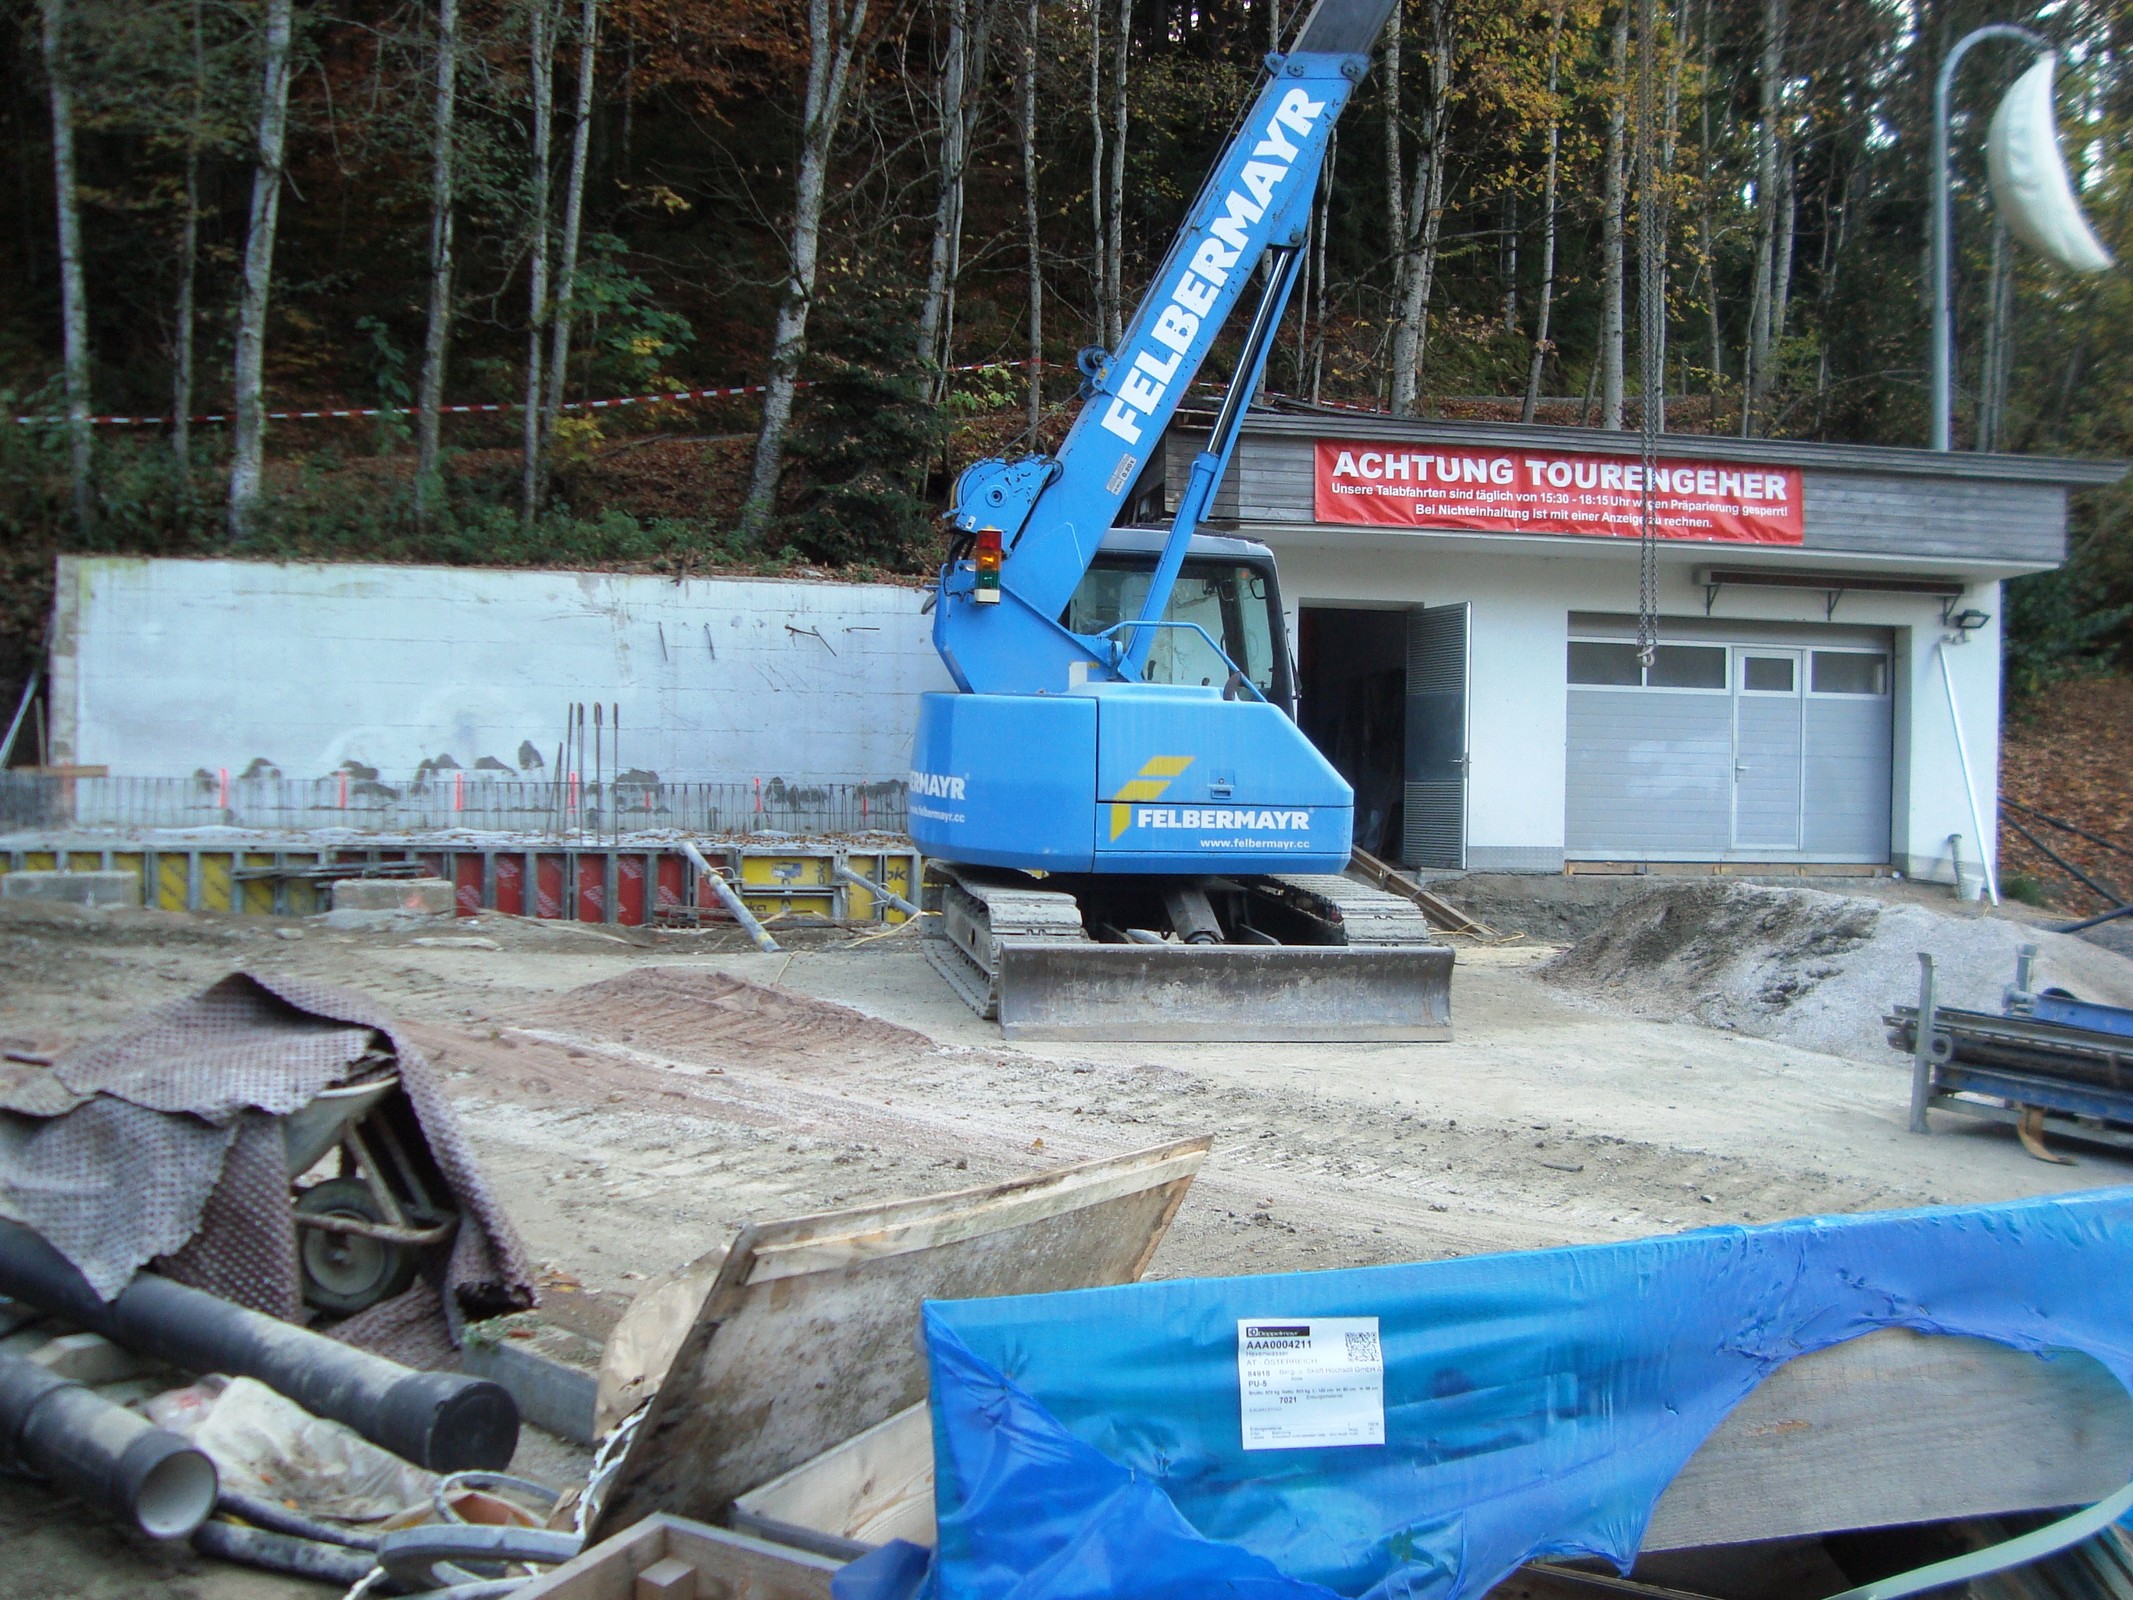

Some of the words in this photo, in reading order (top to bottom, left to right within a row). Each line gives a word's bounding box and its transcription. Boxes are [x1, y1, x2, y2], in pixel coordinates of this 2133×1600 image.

[1101, 88, 1325, 445] FELBERMAYR
[1332, 451, 1514, 485] ACHTUNG
[1525, 459, 1787, 500] TOURENGEHER
[1332, 482, 1373, 495] Unsere
[1376, 484, 1447, 498] Talabfahrten
[1449, 488, 1473, 500] sind
[1476, 489, 1513, 502] täglich
[1516, 493, 1537, 502] von
[1540, 492, 1569, 504] 15:30
[1579, 494, 1609, 505] 18:15
[1610, 495, 1630, 506] Uhr
[1632, 499, 1668, 511] wgen
[1671, 499, 1739, 515] Präparierung
[1742, 505, 1788, 517] gesperrt!
[1415, 503, 1435, 515] Bei
[1438, 504, 1530, 521] Nichteinhaltung
[1533, 508, 1548, 519] ist
[1550, 510, 1568, 520] mit
[1571, 510, 1600, 521] einer
[1601, 511, 1645, 526] Anzeige
[1664, 516, 1713, 528] rechnen.
[1137, 809, 1310, 830] FELBERMAYR
[1200, 838, 1310, 850] www.felbermayr.cc
[1246, 1340, 1312, 1350] AAA0004211
[1248, 1380, 1268, 1388] PU-5
[1279, 1396, 1298, 1404] 7021
